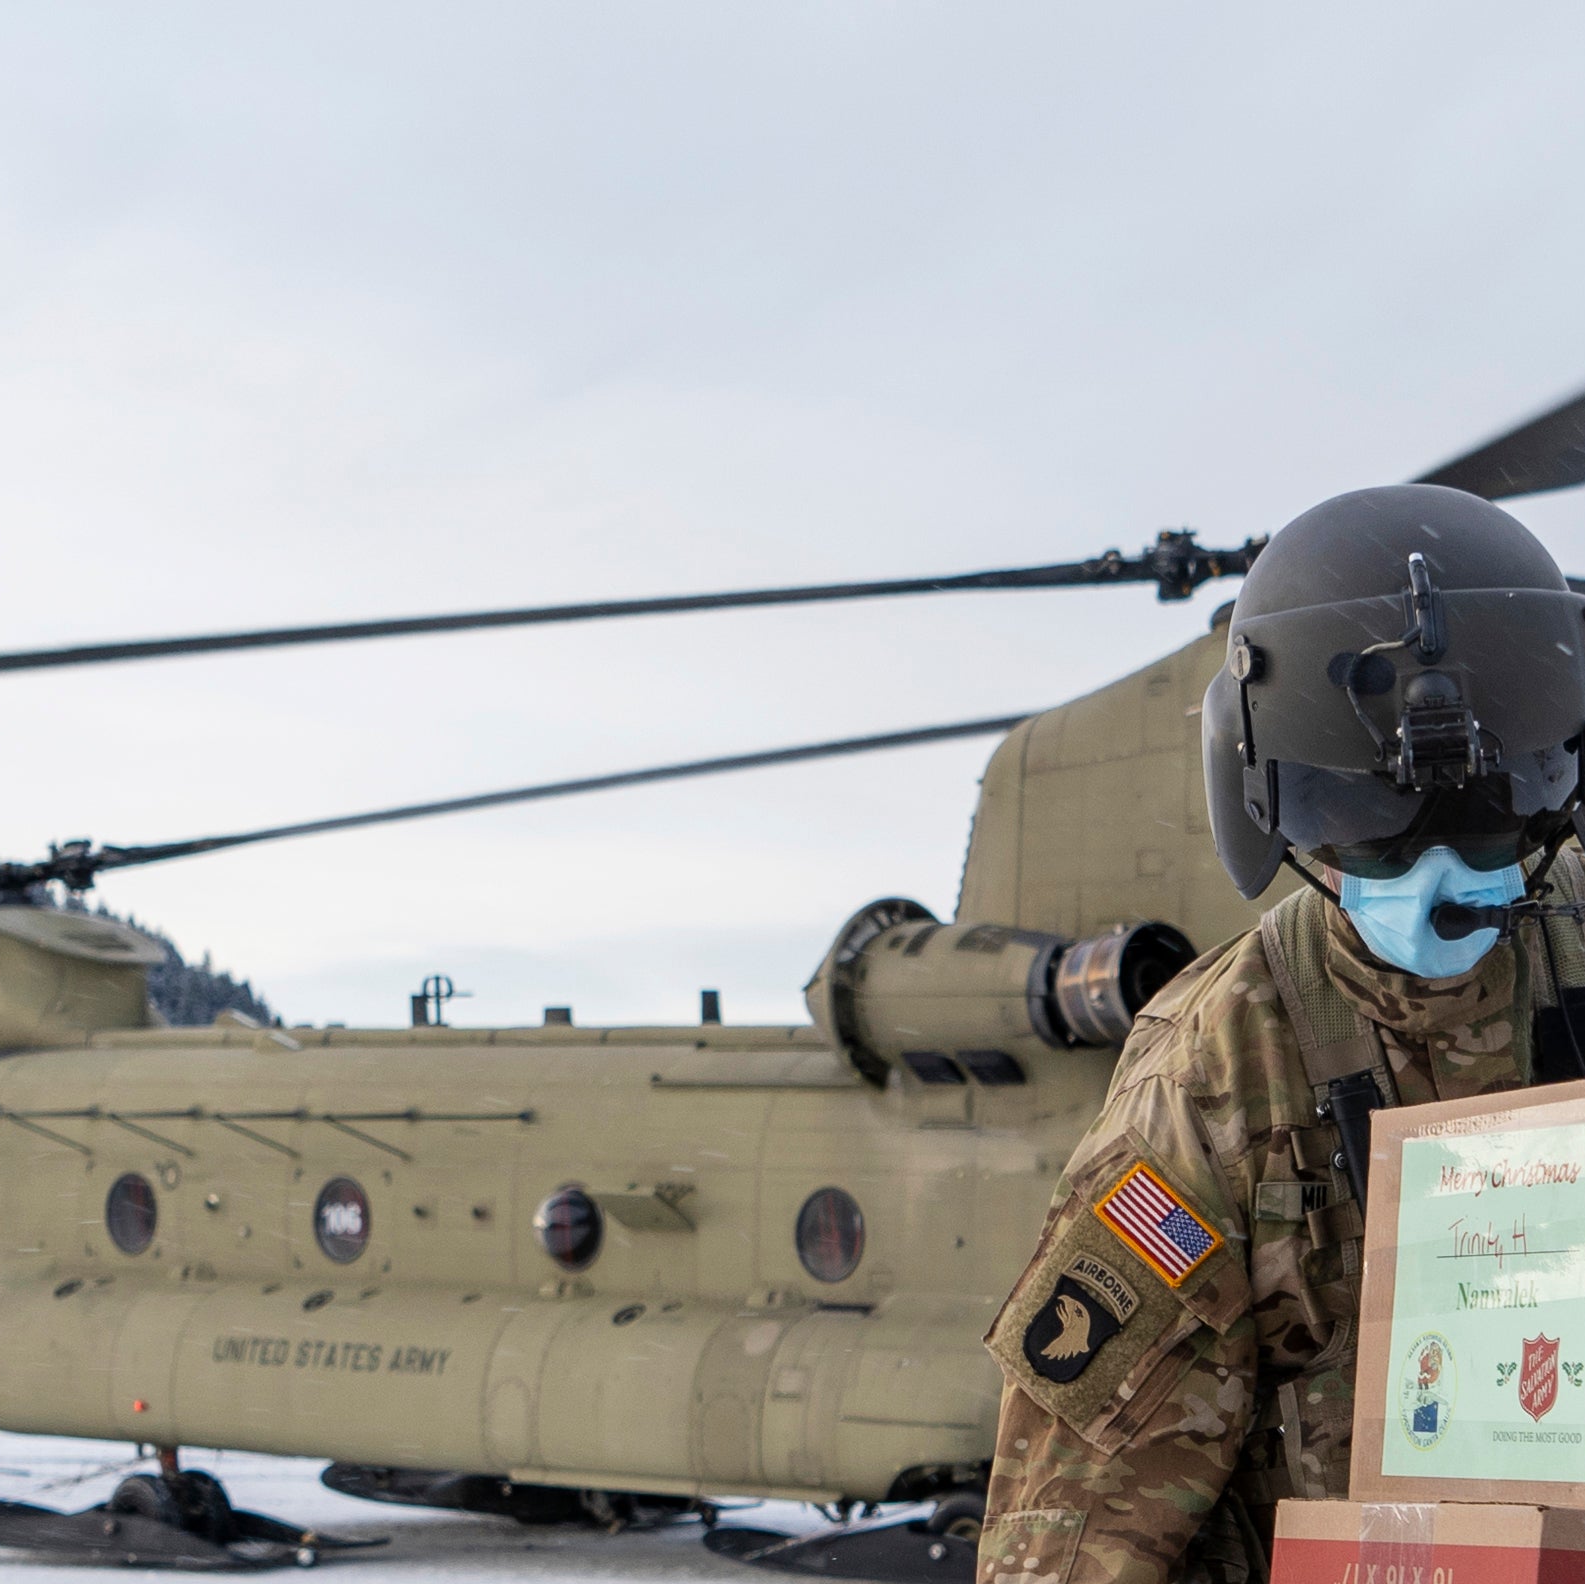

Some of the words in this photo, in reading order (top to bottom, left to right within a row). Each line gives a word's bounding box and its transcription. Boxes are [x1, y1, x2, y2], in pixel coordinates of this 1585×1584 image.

[1440, 1165, 1487, 1197] Merry
[1491, 1158, 1582, 1188] Christmas
[1073, 1258, 1134, 1315] AIRBORNE
[1456, 1279, 1538, 1310] Nanwalek
[212, 1335, 290, 1367] UNITED
[293, 1338, 383, 1373] STATES
[387, 1344, 453, 1376] ARMY
[1492, 1431, 1517, 1443] DOING
[1518, 1431, 1534, 1443] THE
[1535, 1431, 1557, 1443] MOST
[1558, 1431, 1582, 1444] GOOD
